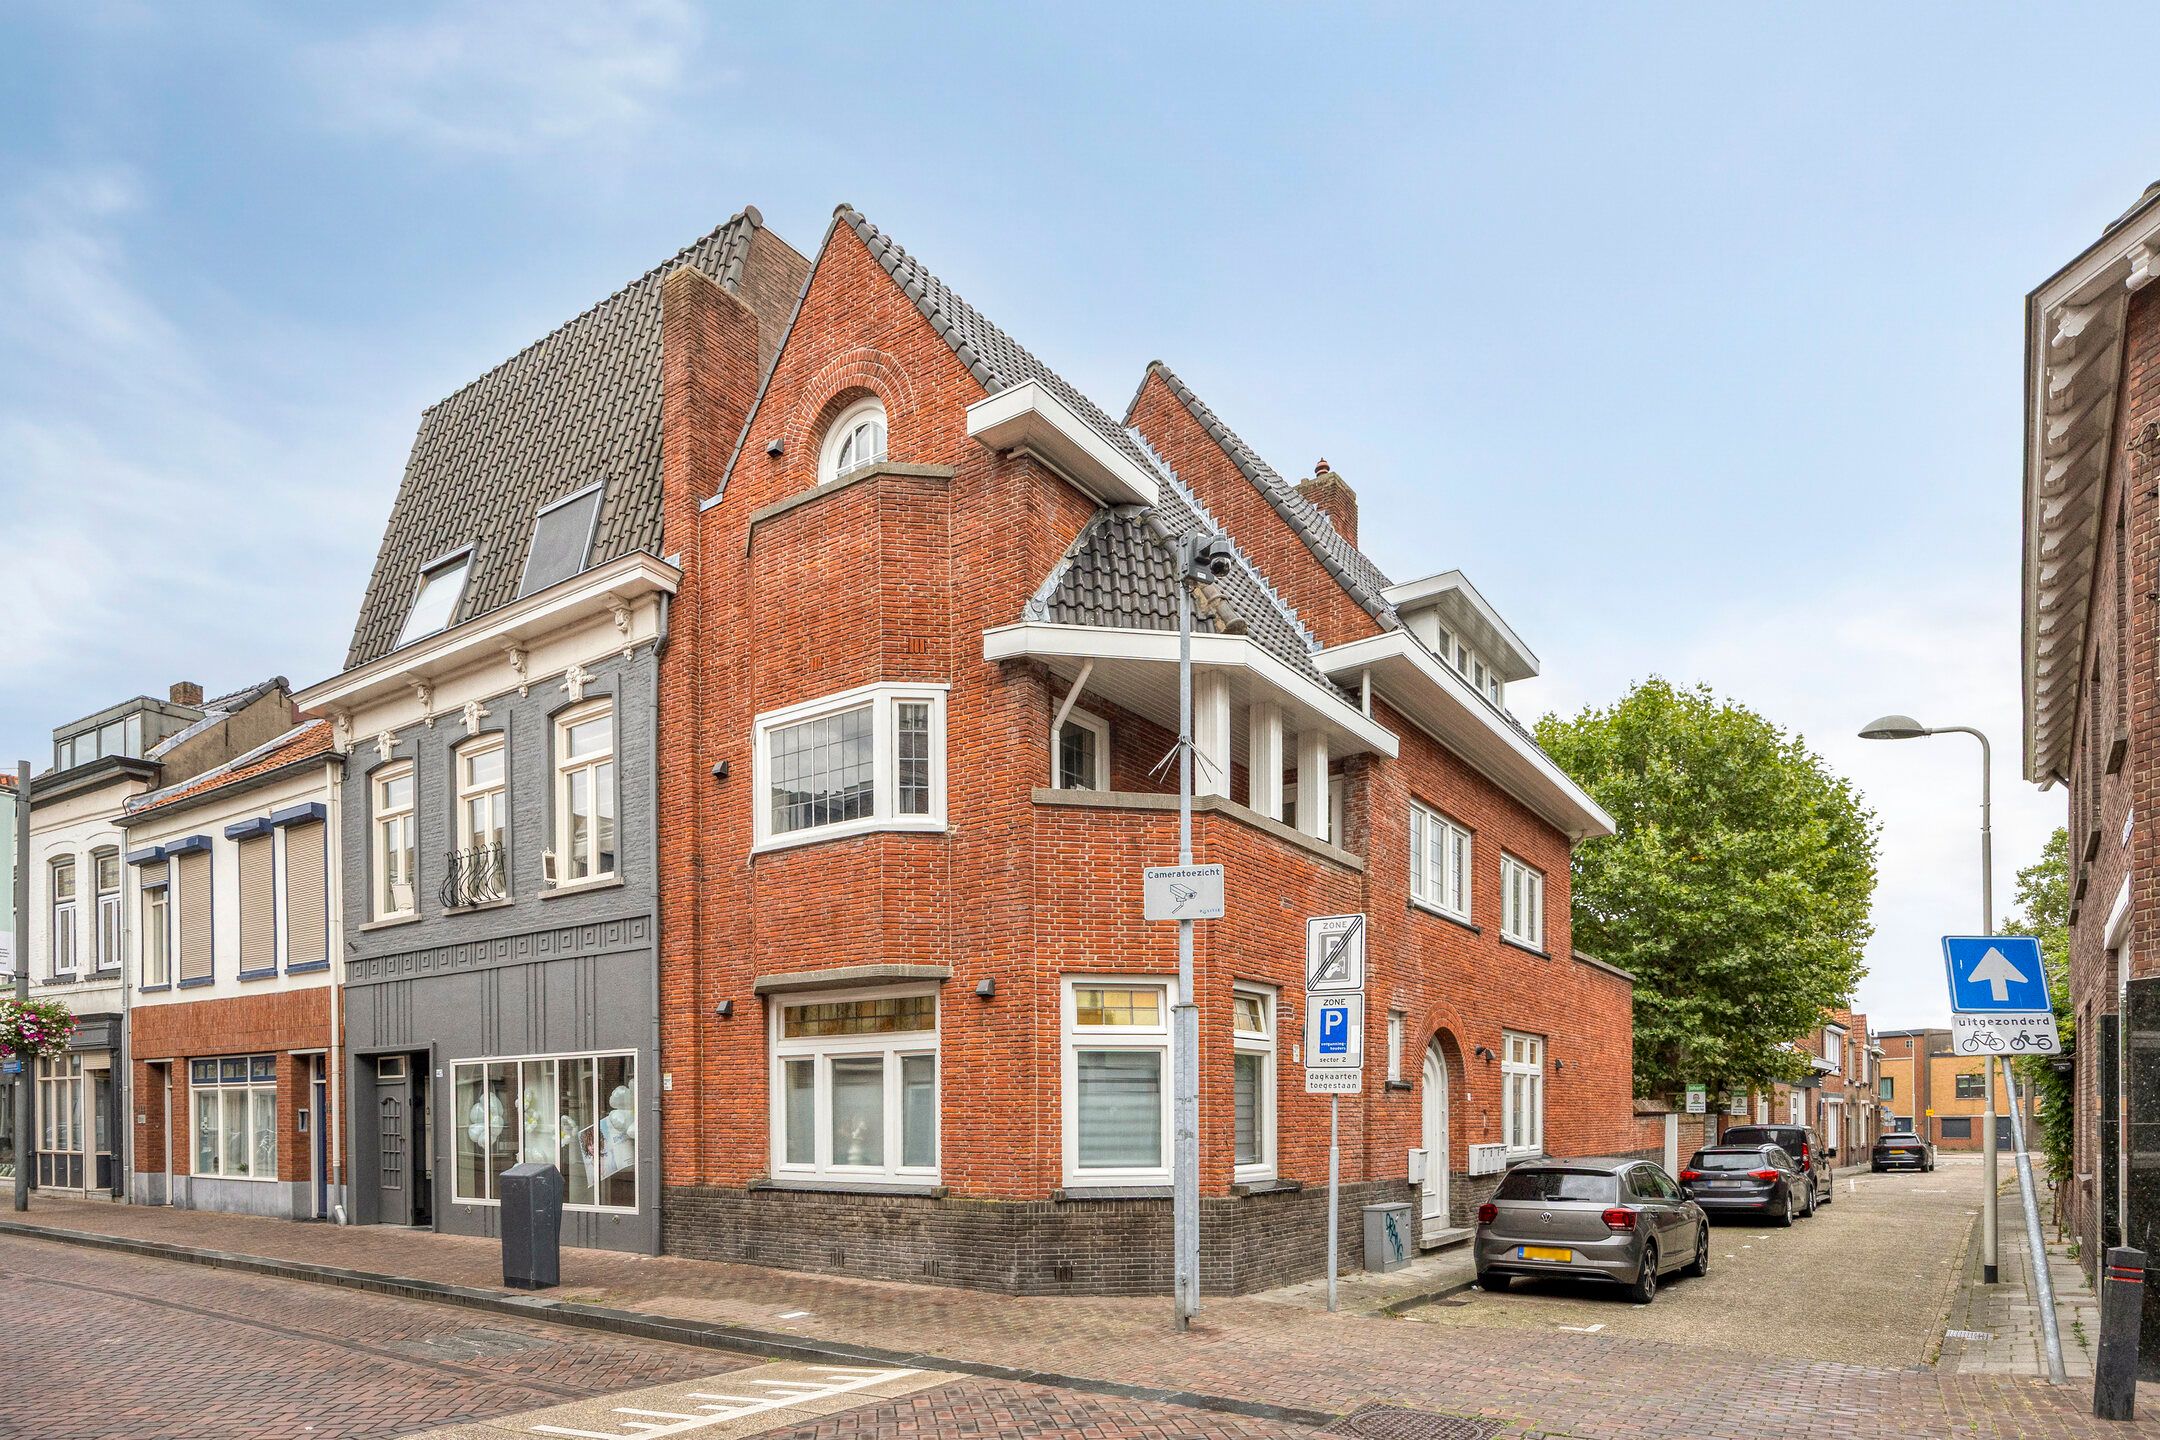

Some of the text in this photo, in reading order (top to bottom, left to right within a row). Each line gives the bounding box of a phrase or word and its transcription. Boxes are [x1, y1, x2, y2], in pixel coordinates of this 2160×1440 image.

[1147, 868, 1220, 879] Cameratoezicht
[1323, 921, 1347, 930] ZONE
[1323, 998, 1346, 1006] ZONE
[1325, 1010, 1343, 1035] P
[1958, 1017, 2050, 1027] uitgezonderd
[1309, 1073, 1358, 1081] dagkaarten
